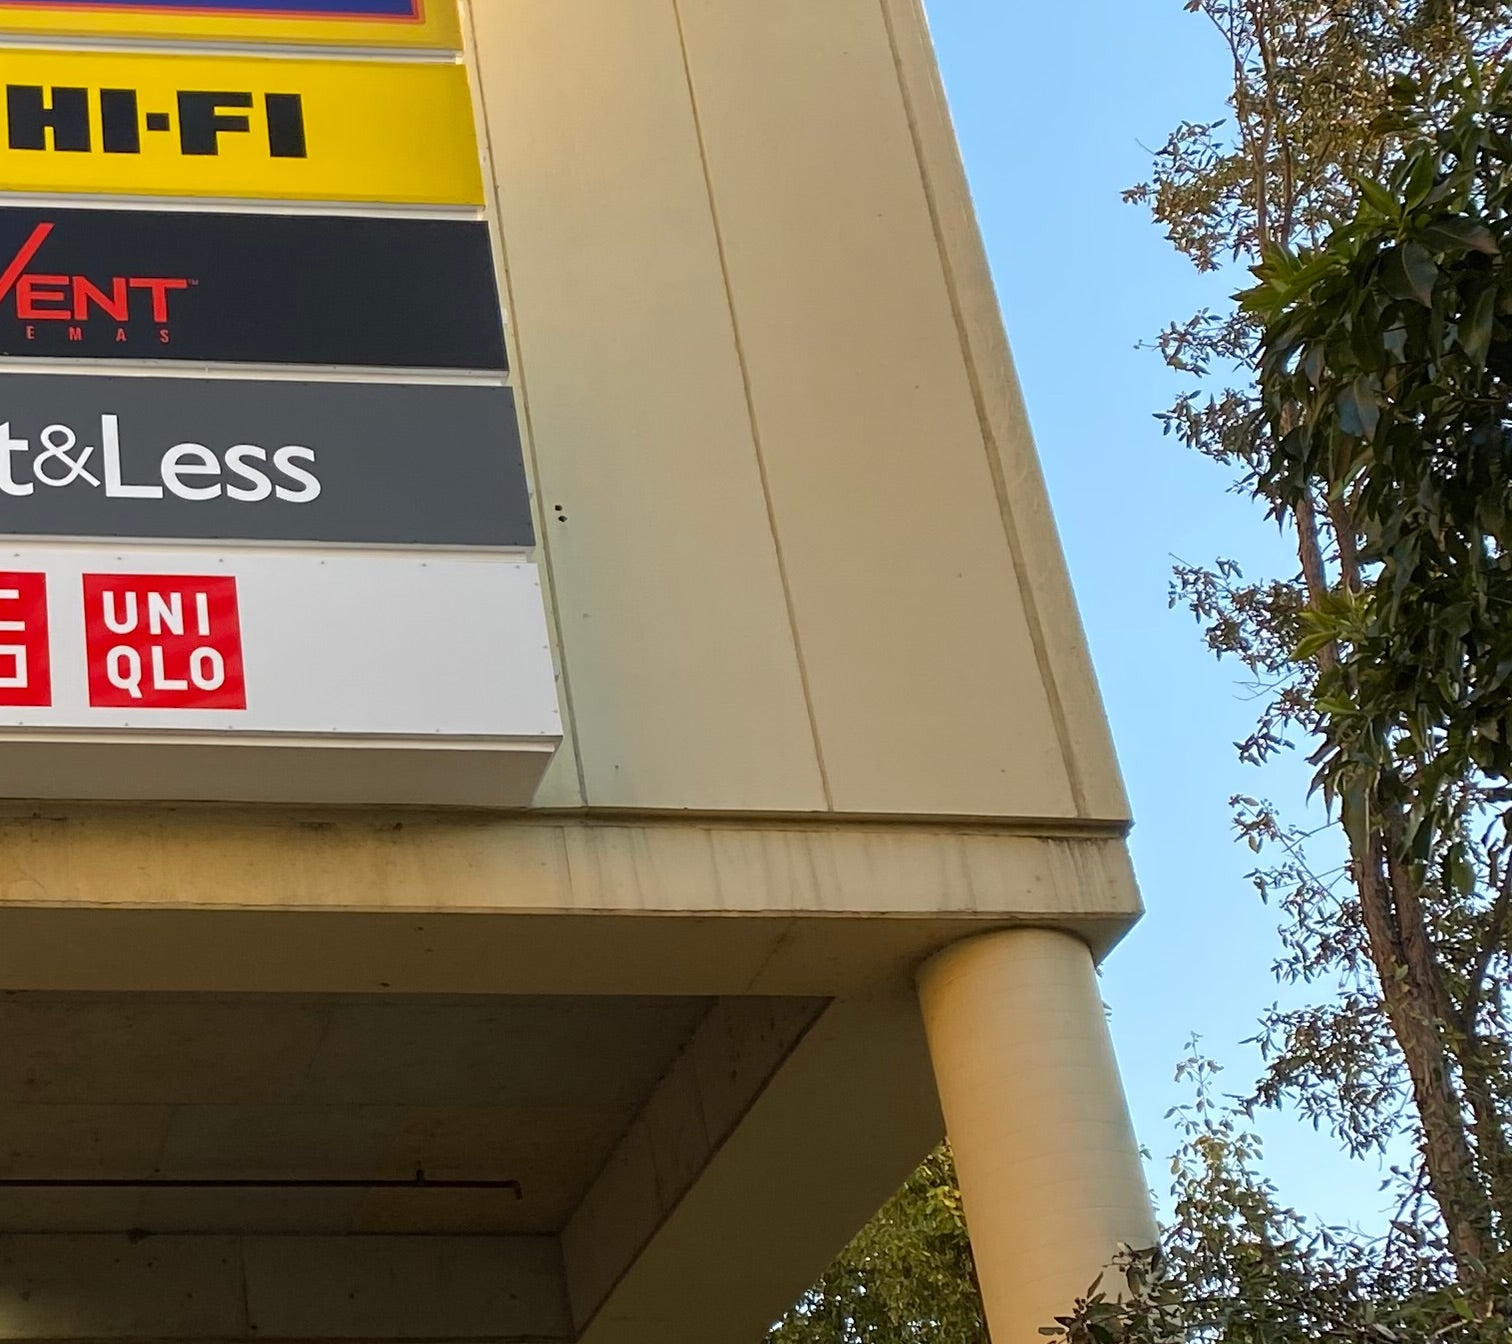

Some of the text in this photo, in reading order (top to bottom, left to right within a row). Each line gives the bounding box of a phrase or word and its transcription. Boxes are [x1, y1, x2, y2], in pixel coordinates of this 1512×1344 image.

[5, 83, 308, 159] HI-FI
[101, 589, 211, 637] UNI
[105, 645, 226, 699] QLO
